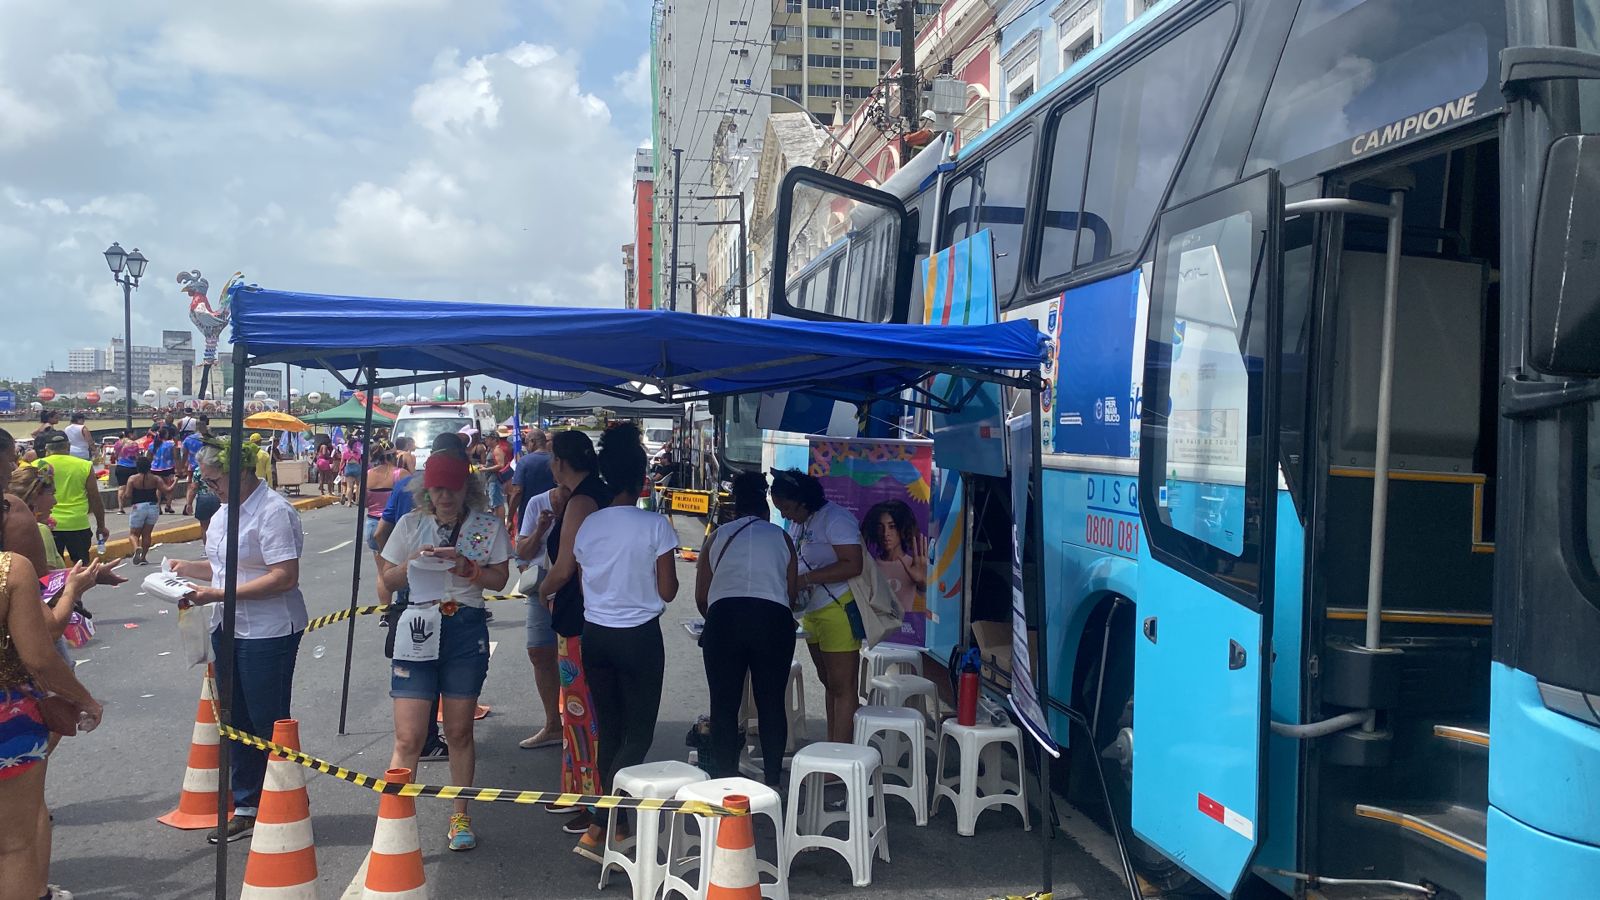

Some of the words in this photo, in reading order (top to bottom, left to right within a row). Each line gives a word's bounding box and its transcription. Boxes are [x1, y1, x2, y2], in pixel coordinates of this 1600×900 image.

[1351, 92, 1478, 155] CAMPIONE
[1105, 413, 1120, 422] BUCO
[1086, 514, 1114, 549] 0800
[1118, 520, 1139, 554] 081
